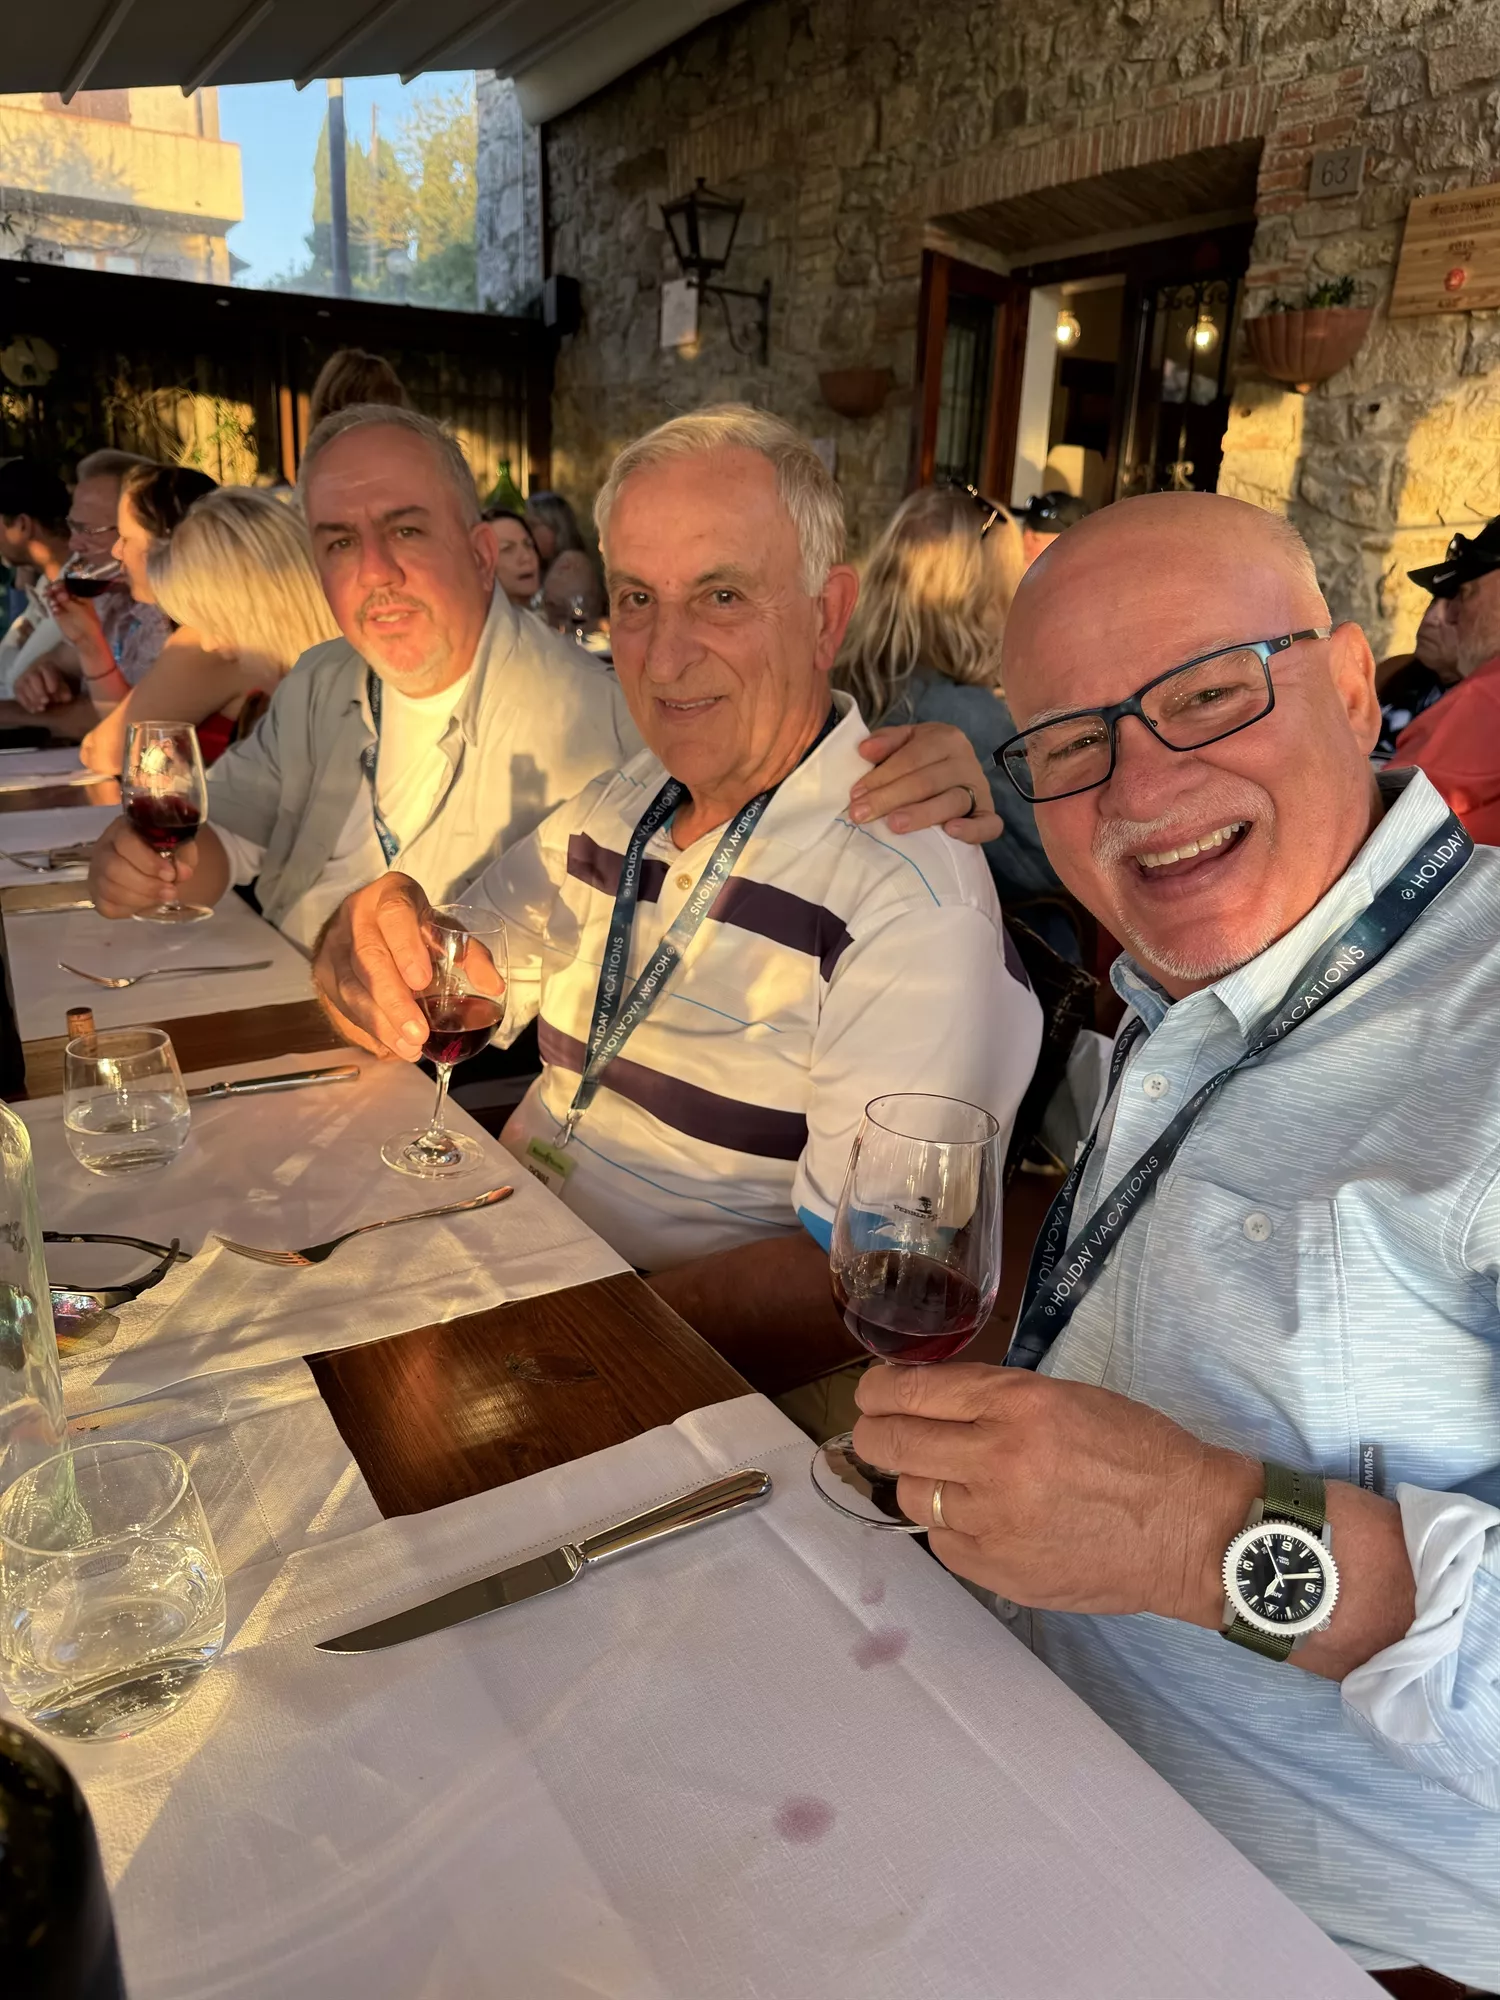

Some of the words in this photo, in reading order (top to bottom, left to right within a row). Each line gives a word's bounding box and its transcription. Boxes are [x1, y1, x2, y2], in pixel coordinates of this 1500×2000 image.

[1321, 157, 1350, 187] 63
[625, 840, 642, 886] HOLIDAY
[637, 784, 682, 838] VACATIONS
[728, 802, 761, 847] HOLIDAY
[690, 847, 733, 915] VACATIONS
[1410, 830, 1464, 889] HOLIDAY
[591, 1011, 609, 1054] OLIDAY
[602, 937, 624, 1009] VACATIONS
[639, 954, 671, 1000] HOLIDAY
[1267, 945, 1365, 1039] VACATIONS
[598, 1000, 643, 1062] VACATIONS
[1063, 1138, 1095, 1202] HOLIDAY
[1036, 1205, 1067, 1294] VACATIO
[1050, 1245, 1094, 1307] HOLIDAY
[1089, 1155, 1159, 1246] VACATIONS
[1242, 1560, 1254, 1571] 3
